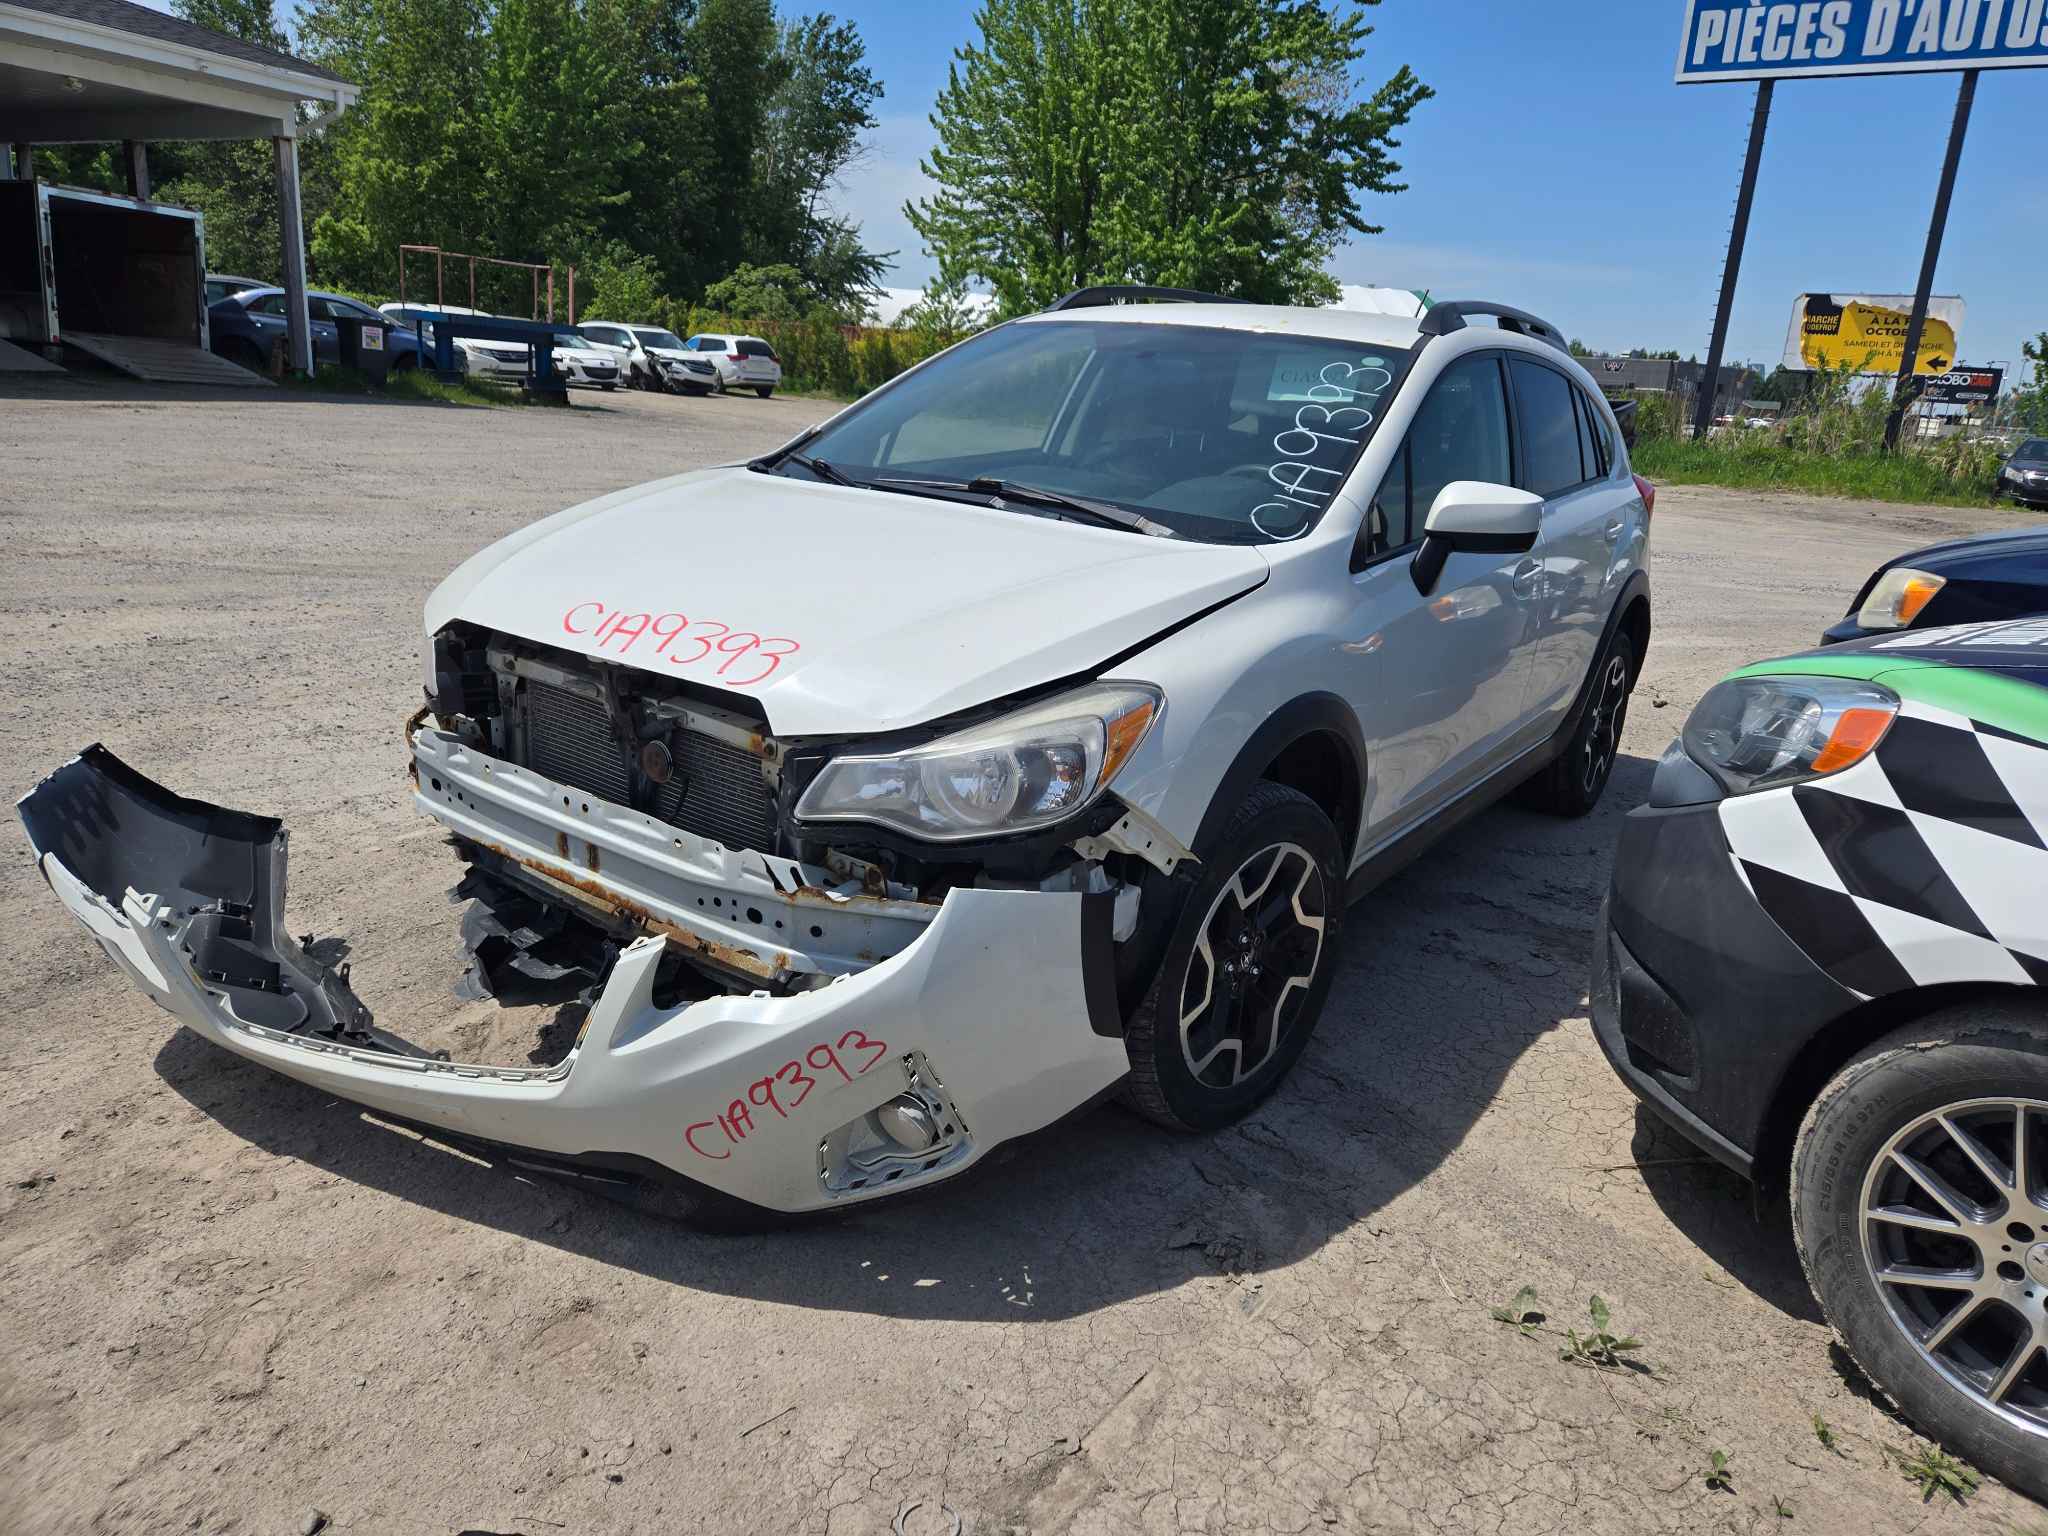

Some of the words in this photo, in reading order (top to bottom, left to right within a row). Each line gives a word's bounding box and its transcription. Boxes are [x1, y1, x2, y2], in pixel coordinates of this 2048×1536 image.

[1692, 0, 1851, 65] PIÈCES
[1861, 0, 2048, 56] D'AUTO
[1866, 327, 1928, 337] OCTOBE
